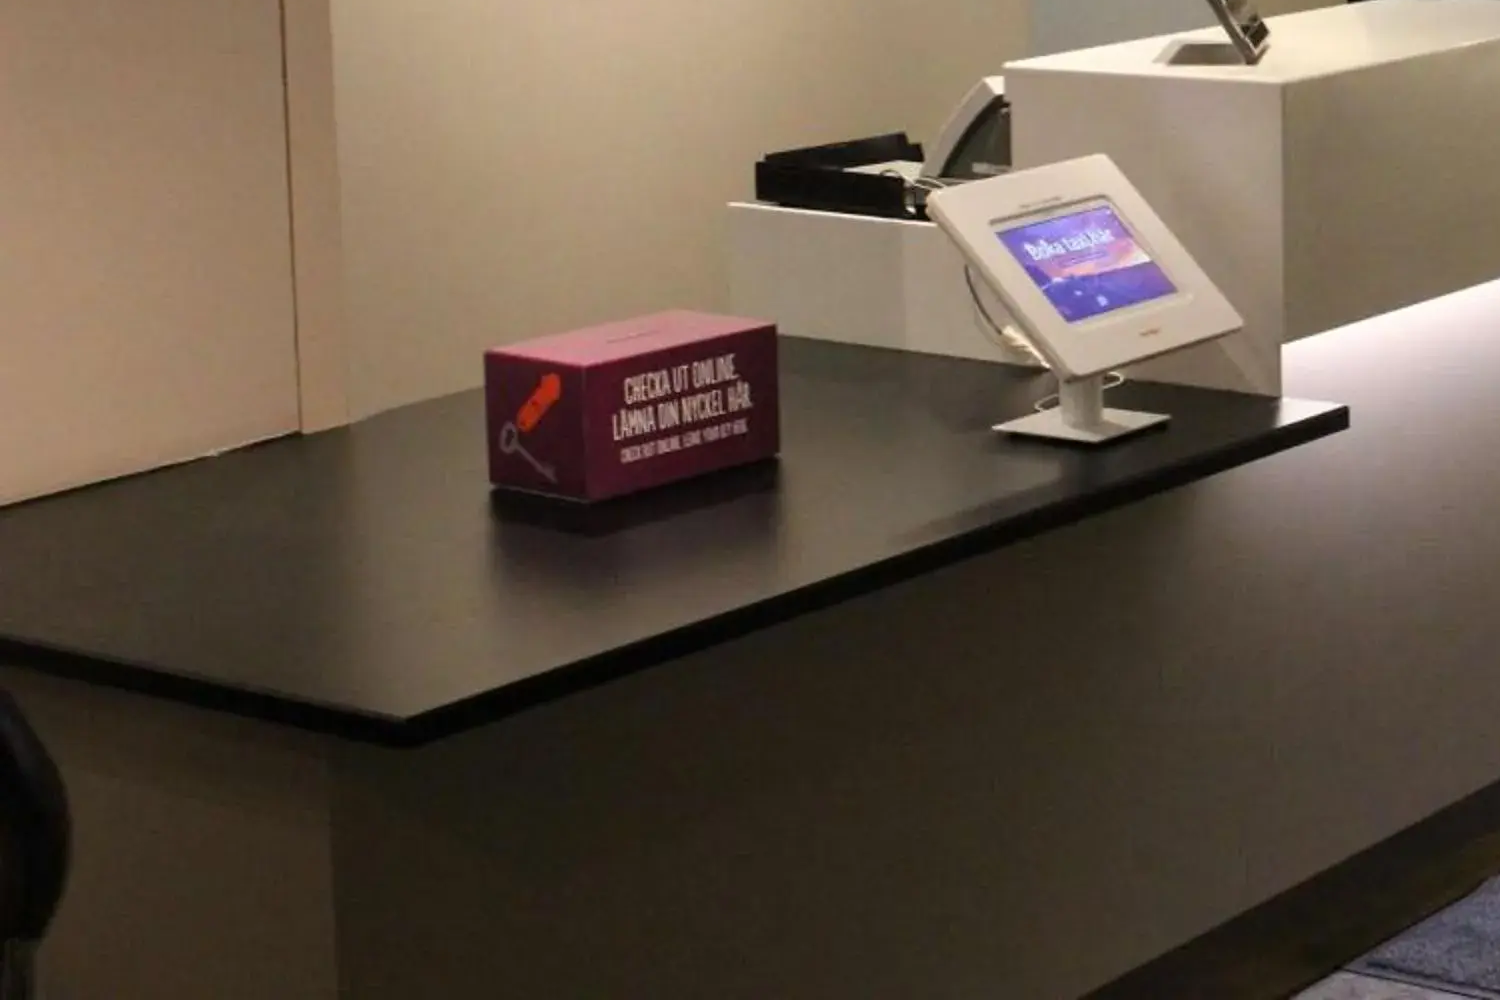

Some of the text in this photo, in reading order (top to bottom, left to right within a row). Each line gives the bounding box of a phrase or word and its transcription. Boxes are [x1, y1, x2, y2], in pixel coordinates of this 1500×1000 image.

[624, 369, 671, 405] CHECKA
[671, 364, 689, 393] UT
[657, 399, 681, 430] DIN
[681, 389, 727, 423] NYCKEL
